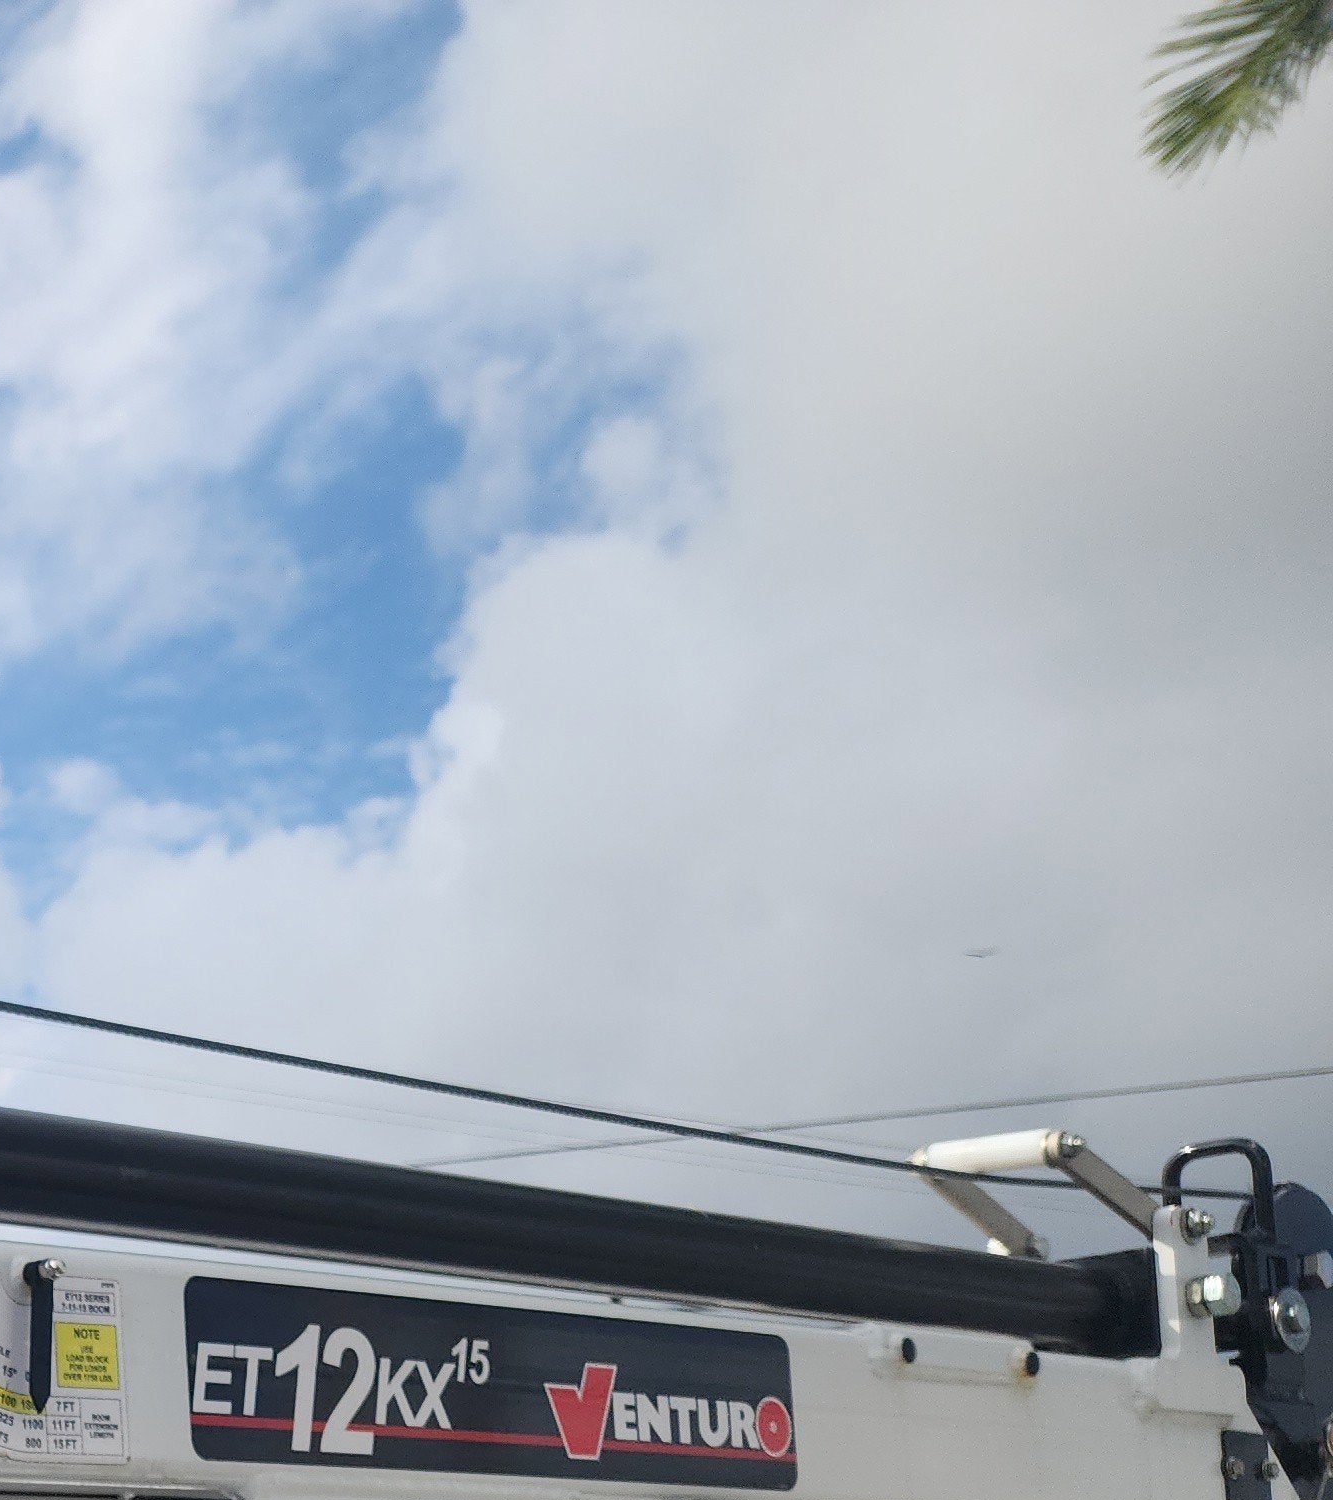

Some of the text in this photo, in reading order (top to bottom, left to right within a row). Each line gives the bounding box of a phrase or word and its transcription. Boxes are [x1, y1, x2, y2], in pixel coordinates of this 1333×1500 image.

[84, 1293, 111, 1304] SERIES
[88, 1304, 111, 1314] BOOM
[73, 1327, 101, 1341] NOTE
[66, 1353, 109, 1364] LOAD BLOCK
[69, 1363, 84, 1371] FOR
[63, 1373, 82, 1381] OVER
[544, 1362, 793, 1461] VENTURO
[22, 1418, 44, 1431] 1100
[84, 1422, 119, 1431] EXTENSION
[90, 1431, 115, 1440] LENGTH
[25, 1436, 42, 1449] 800
